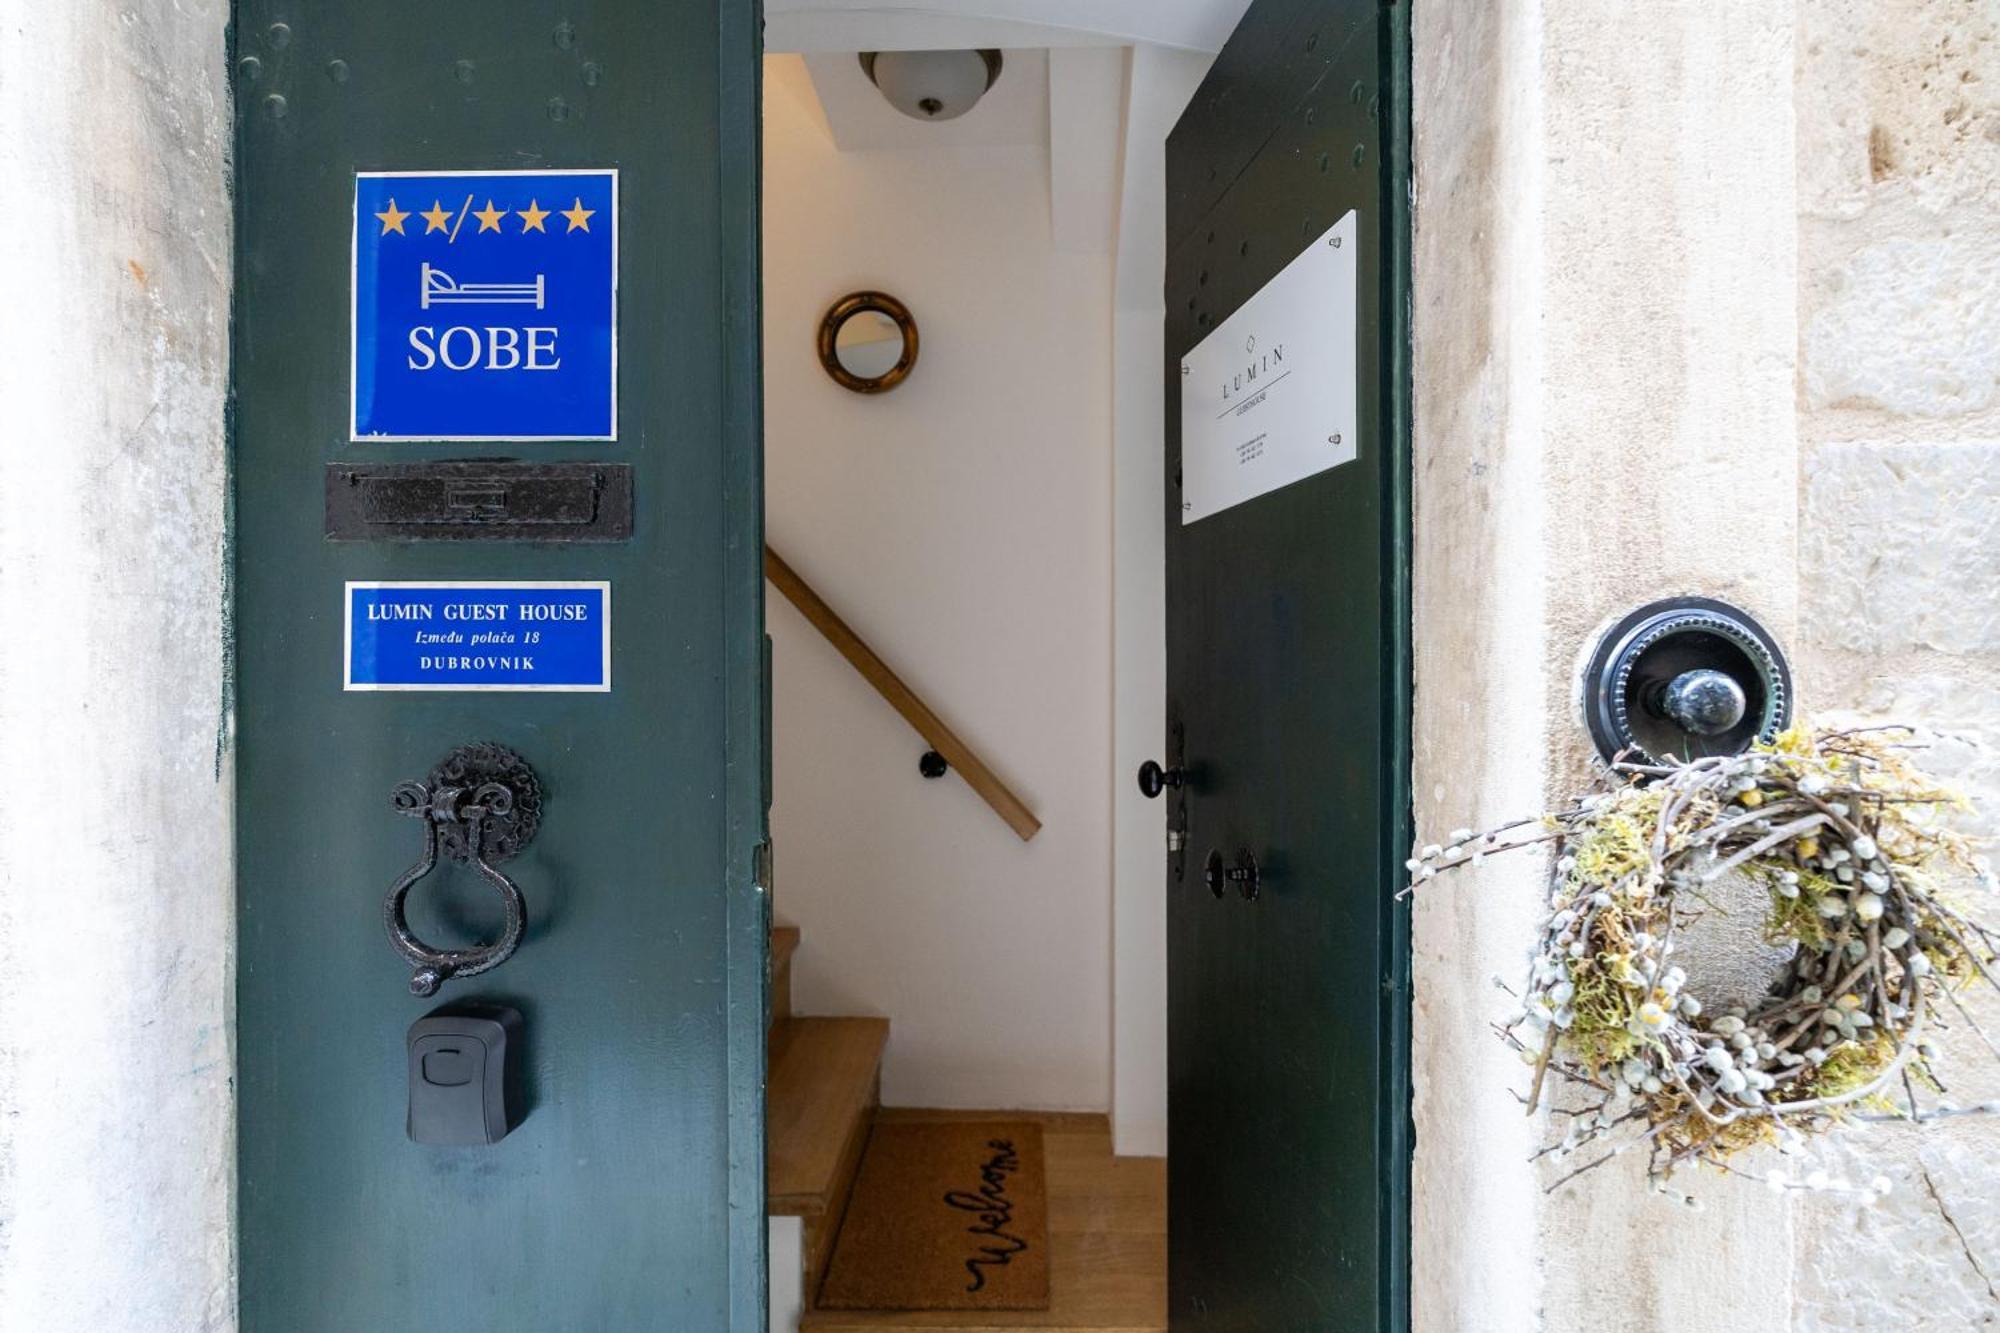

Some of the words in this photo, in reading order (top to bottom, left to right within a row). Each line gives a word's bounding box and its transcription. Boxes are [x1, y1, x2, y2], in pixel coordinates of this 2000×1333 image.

[408, 326, 561, 371] SOBE
[1223, 344, 1283, 399] LUMIN
[368, 604, 432, 620] LUMIN
[444, 604, 509, 621] GUEST
[520, 604, 588, 621] HOUSE
[471, 631, 515, 646] polača
[524, 631, 540, 645] 18
[420, 657, 535, 670] DUBROVNIK
[943, 1139, 1028, 1292] Welcome
